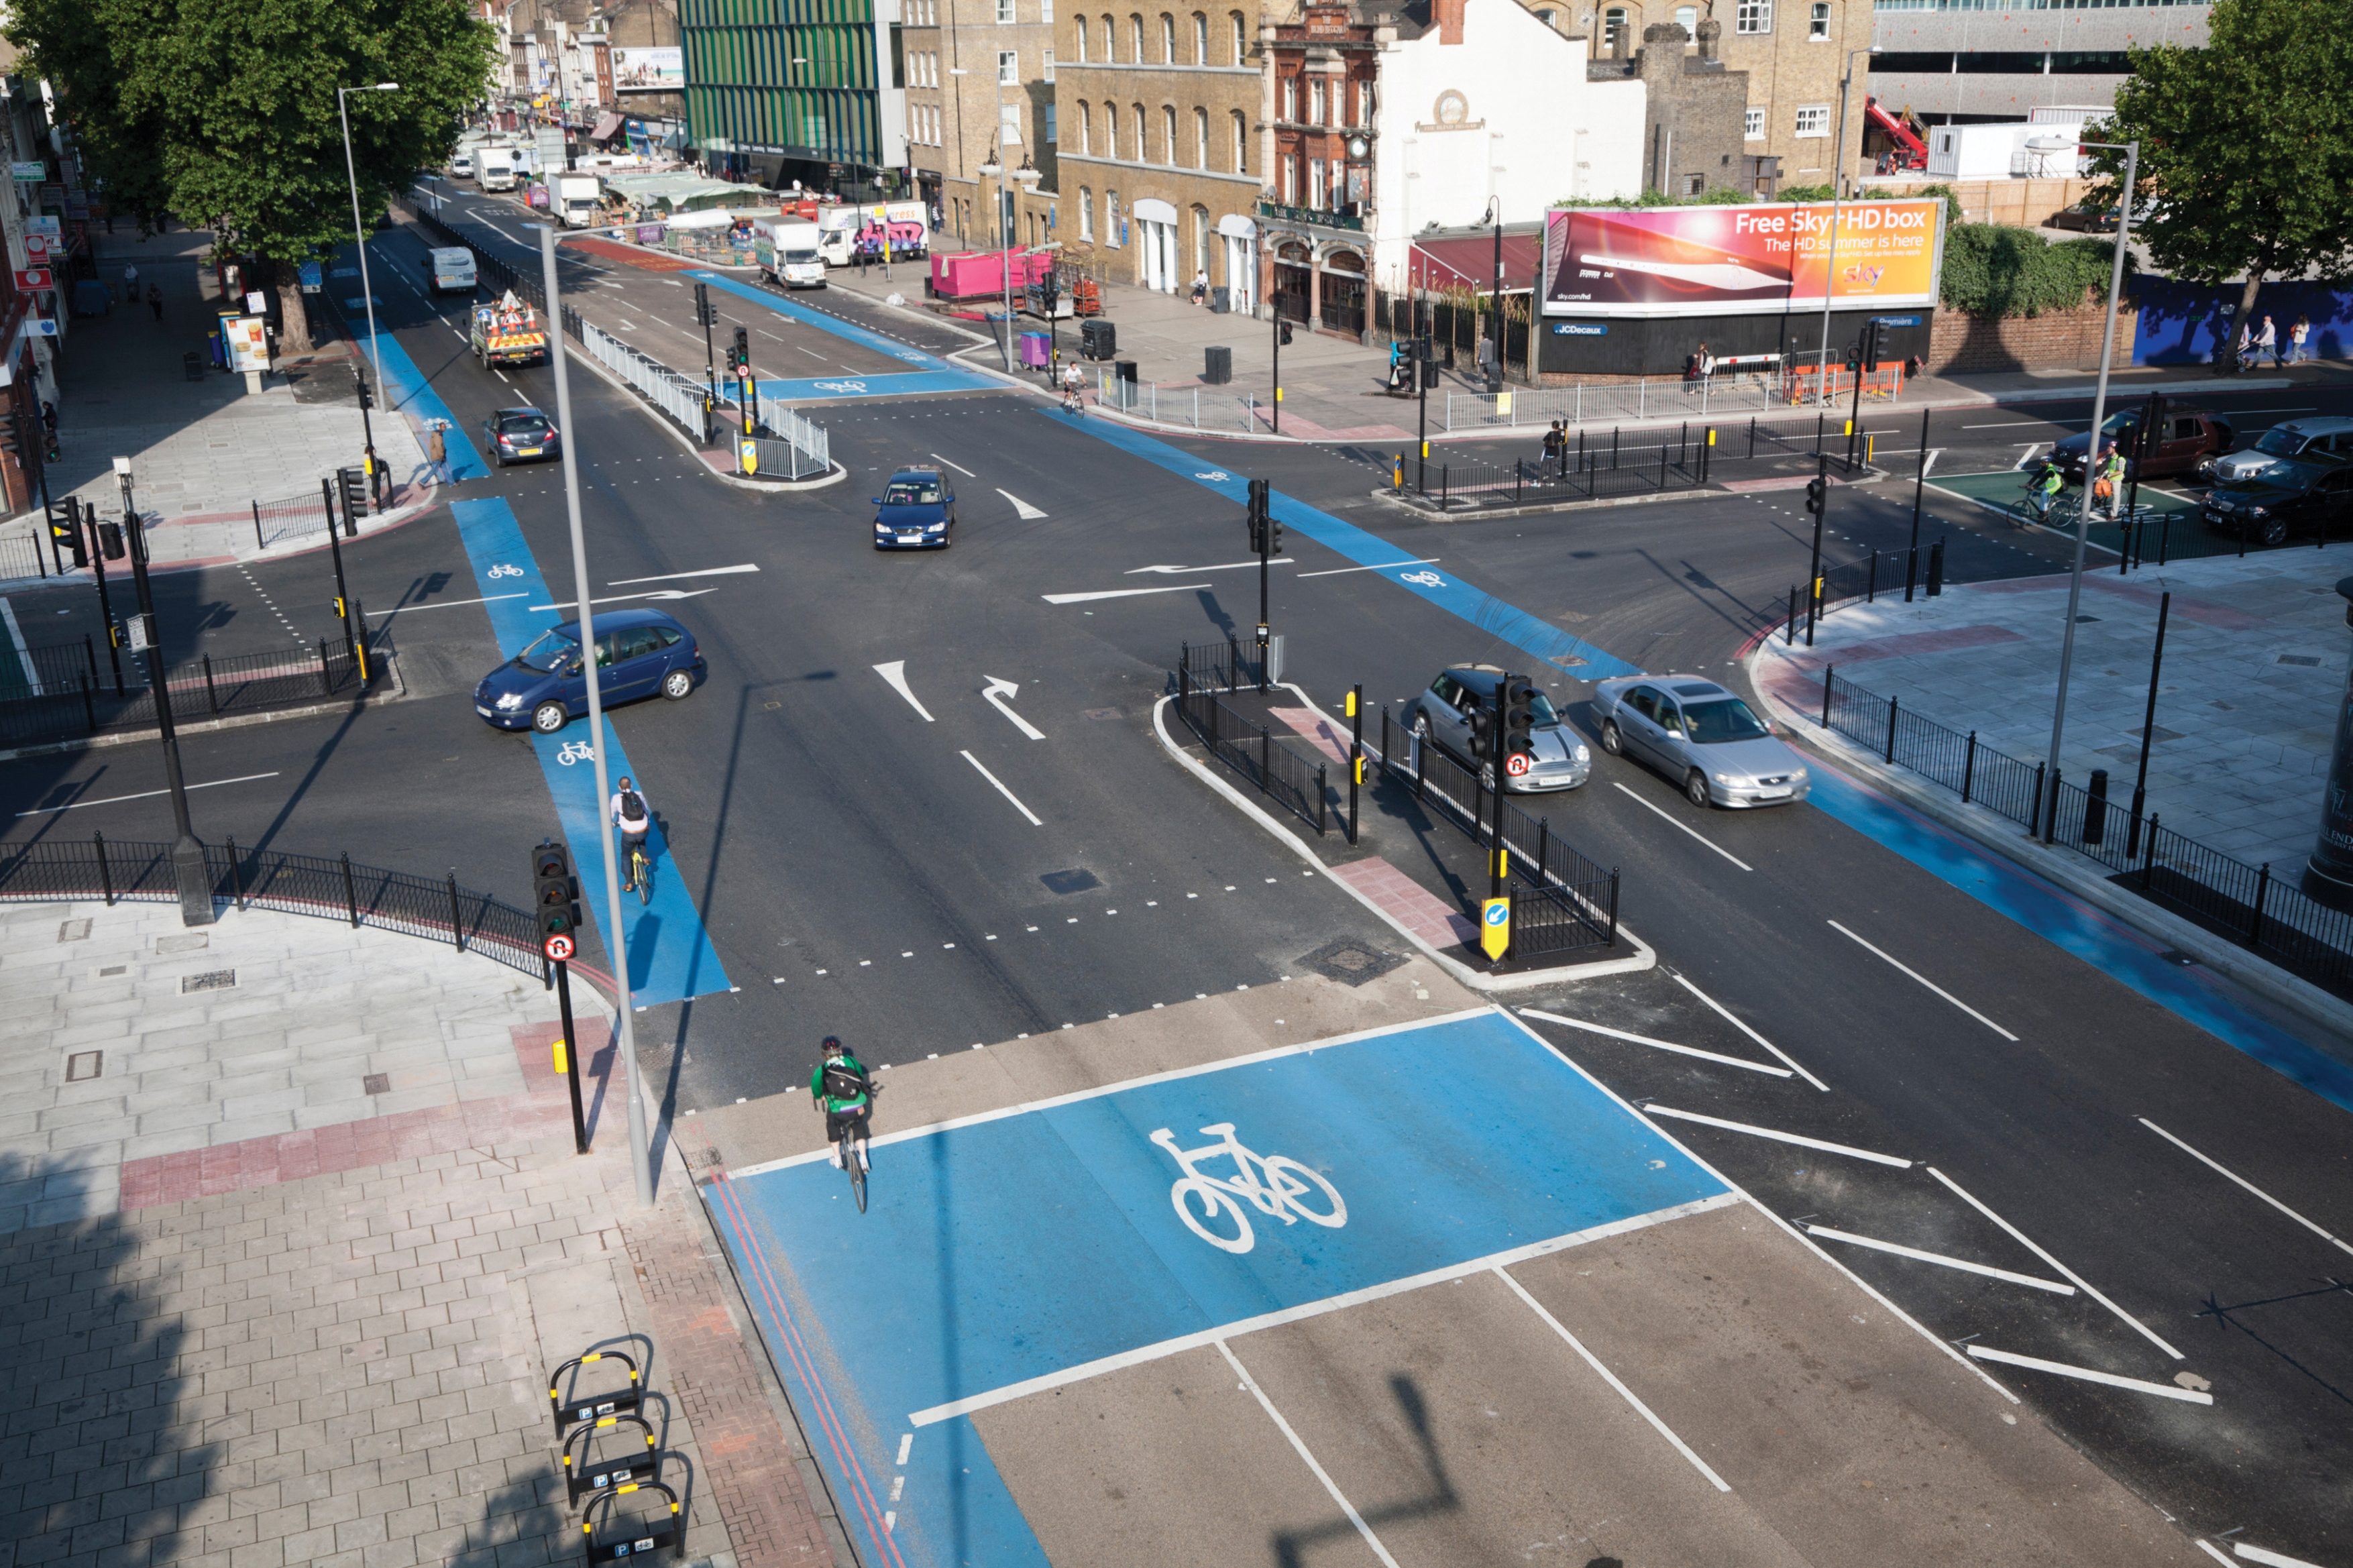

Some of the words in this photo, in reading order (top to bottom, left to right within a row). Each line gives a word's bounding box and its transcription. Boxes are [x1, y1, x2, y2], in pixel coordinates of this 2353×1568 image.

[1322, 15, 1331, 25] THE
[1325, 25, 1344, 34] BEGGAR
[752, 145, 765, 153] Learning
[1736, 213, 1785, 234] Free
[1884, 208, 1926, 229] box
[1765, 238, 1791, 252] The
[1794, 237, 1816, 251] HD
[1878, 234, 1890, 247] is
[1892, 233, 1924, 247] here
[1843, 261, 1885, 286] sky
[1559, 325, 1601, 334] JCDecaux
